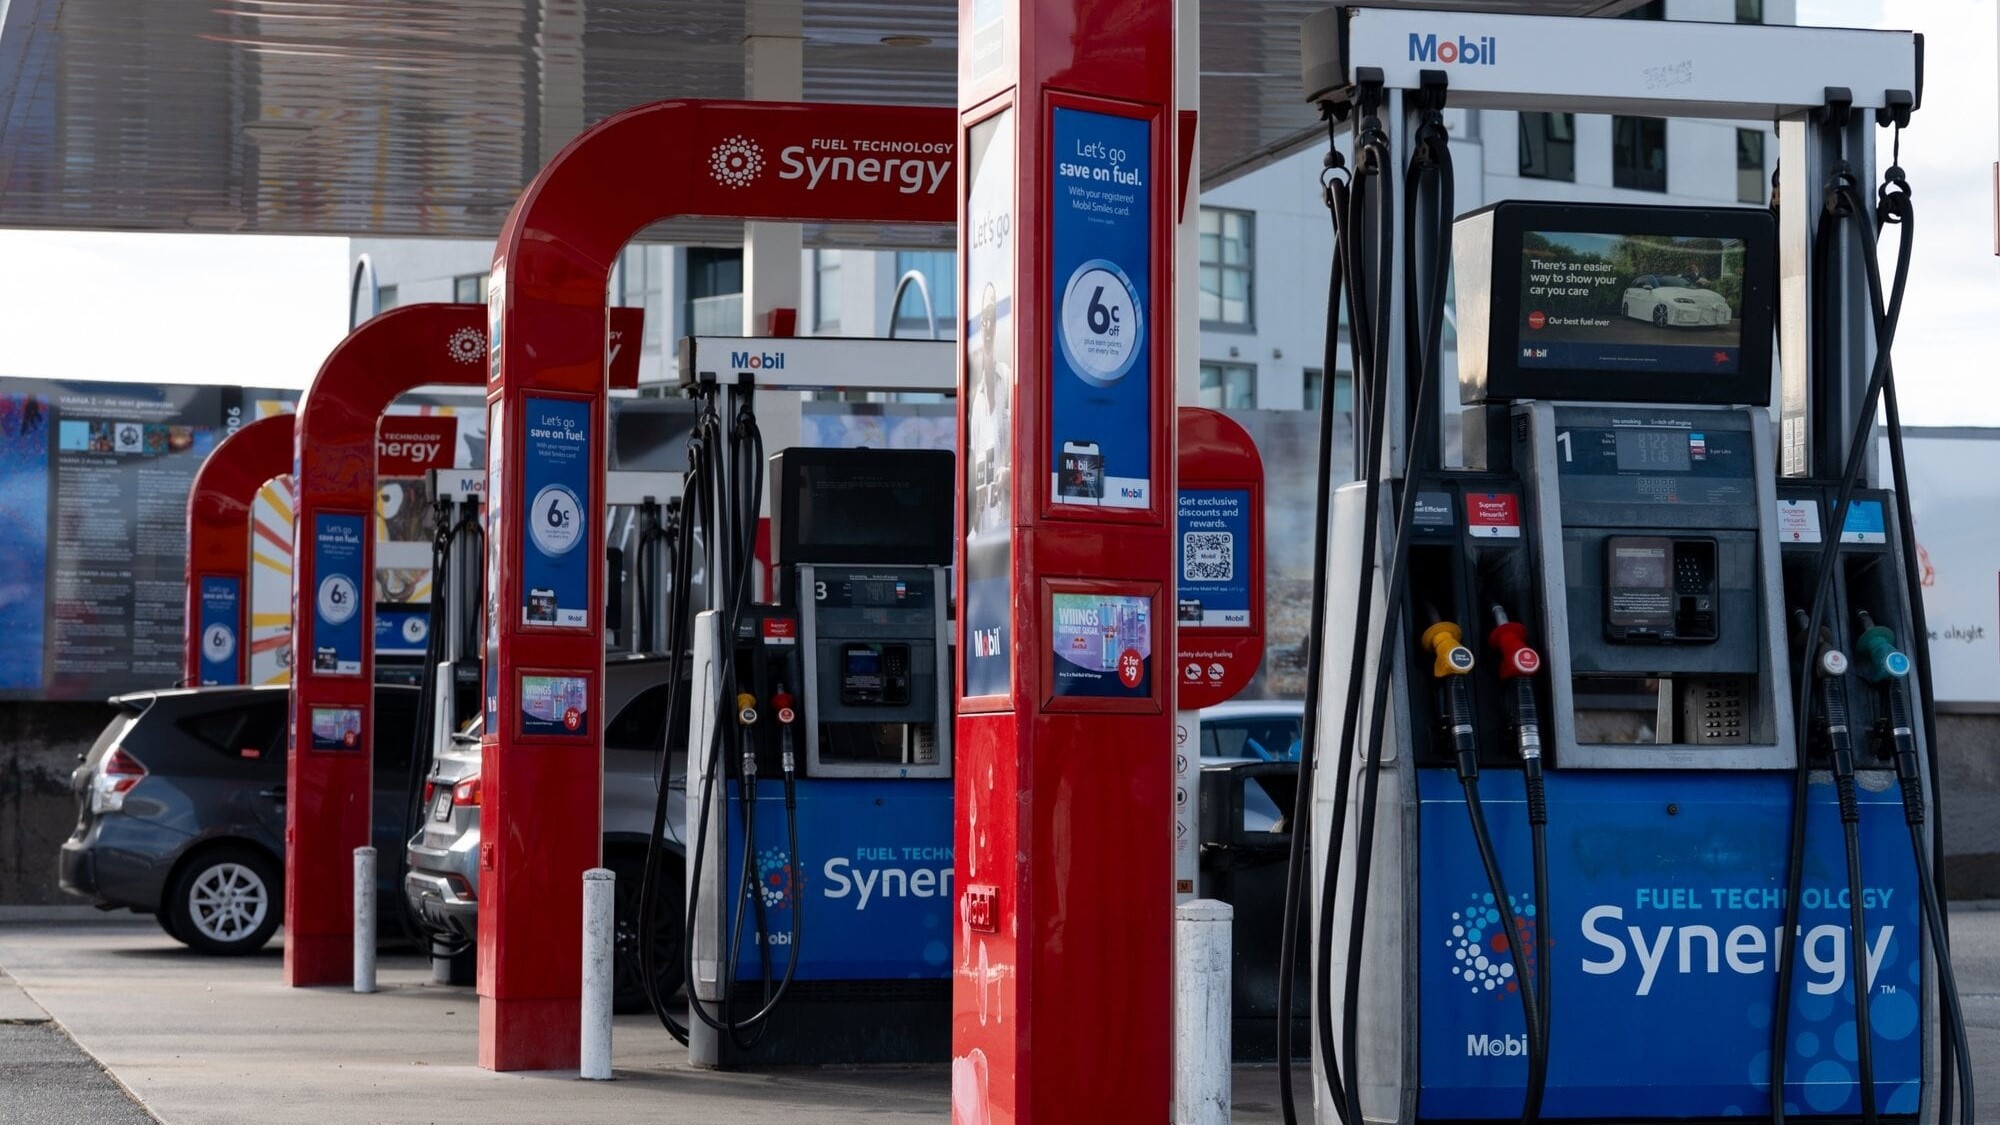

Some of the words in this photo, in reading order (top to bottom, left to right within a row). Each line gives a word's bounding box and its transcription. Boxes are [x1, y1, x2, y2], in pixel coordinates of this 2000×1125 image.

[1409, 33, 1495, 65] Mobil
[812, 138, 848, 150] FUEL
[853, 140, 953, 154] TECHNOLOGY
[1077, 138, 1106, 159] Let's
[1109, 148, 1126, 166] go
[779, 146, 952, 194] Synergy
[1060, 163, 1090, 178] save
[1093, 168, 1110, 181] on
[1113, 165, 1142, 186] fuel.
[1069, 185, 1085, 196] With
[1086, 190, 1101, 199] your
[1102, 192, 1134, 203] registered
[1072, 200, 1092, 210] Mobil
[1092, 202, 1113, 213] Smiles
[973, 210, 994, 249] Let's
[997, 213, 1010, 249] go
[1531, 259, 1567, 271] There's
[1569, 262, 1581, 271] an
[1583, 262, 1613, 272] easier
[1530, 274, 1550, 284] way
[1553, 273, 1563, 283] to
[1566, 273, 1593, 285] show
[1594, 276, 1616, 287] your
[1530, 287, 1544, 295] car
[1547, 287, 1566, 297] you
[1568, 288, 1589, 296] care
[1087, 286, 1119, 335] 6c
[1548, 317, 1562, 326] Our
[1563, 317, 1579, 326] best
[1580, 318, 1593, 326] fuel
[1108, 325, 1120, 336] off
[732, 351, 784, 370] Mobil
[1523, 348, 1547, 358] Mobil
[227, 407, 241, 435] 006
[542, 414, 561, 427] Let's
[563, 419, 575, 430] go
[385, 433, 441, 441] TECHNOLOGY
[530, 428, 550, 438] save
[552, 431, 564, 439] on
[566, 429, 585, 441] fuel.
[378, 442, 440, 462] nergy
[1557, 431, 1573, 462] 1
[1121, 487, 1143, 498] Mobil
[1179, 497, 1196, 506] Get
[1197, 497, 1238, 506] exclusive
[1178, 508, 1221, 517] discounts
[1222, 508, 1238, 517] and
[1190, 519, 1227, 528] rewards.
[815, 581, 827, 600] 3
[974, 625, 1001, 658] Mobil
[1123, 656, 1129, 666] 2
[1129, 656, 1139, 666] for
[1195, 651, 1213, 659] during
[1125, 667, 1137, 681] $9
[857, 847, 897, 860] FUEL
[902, 847, 954, 860] TECHN
[824, 857, 955, 910] Syner
[1636, 888, 1702, 910] FUEL
[1711, 888, 1894, 910] TECHOLOGY
[755, 931, 792, 945] obi
[1467, 1034, 1528, 1057] Mobi
